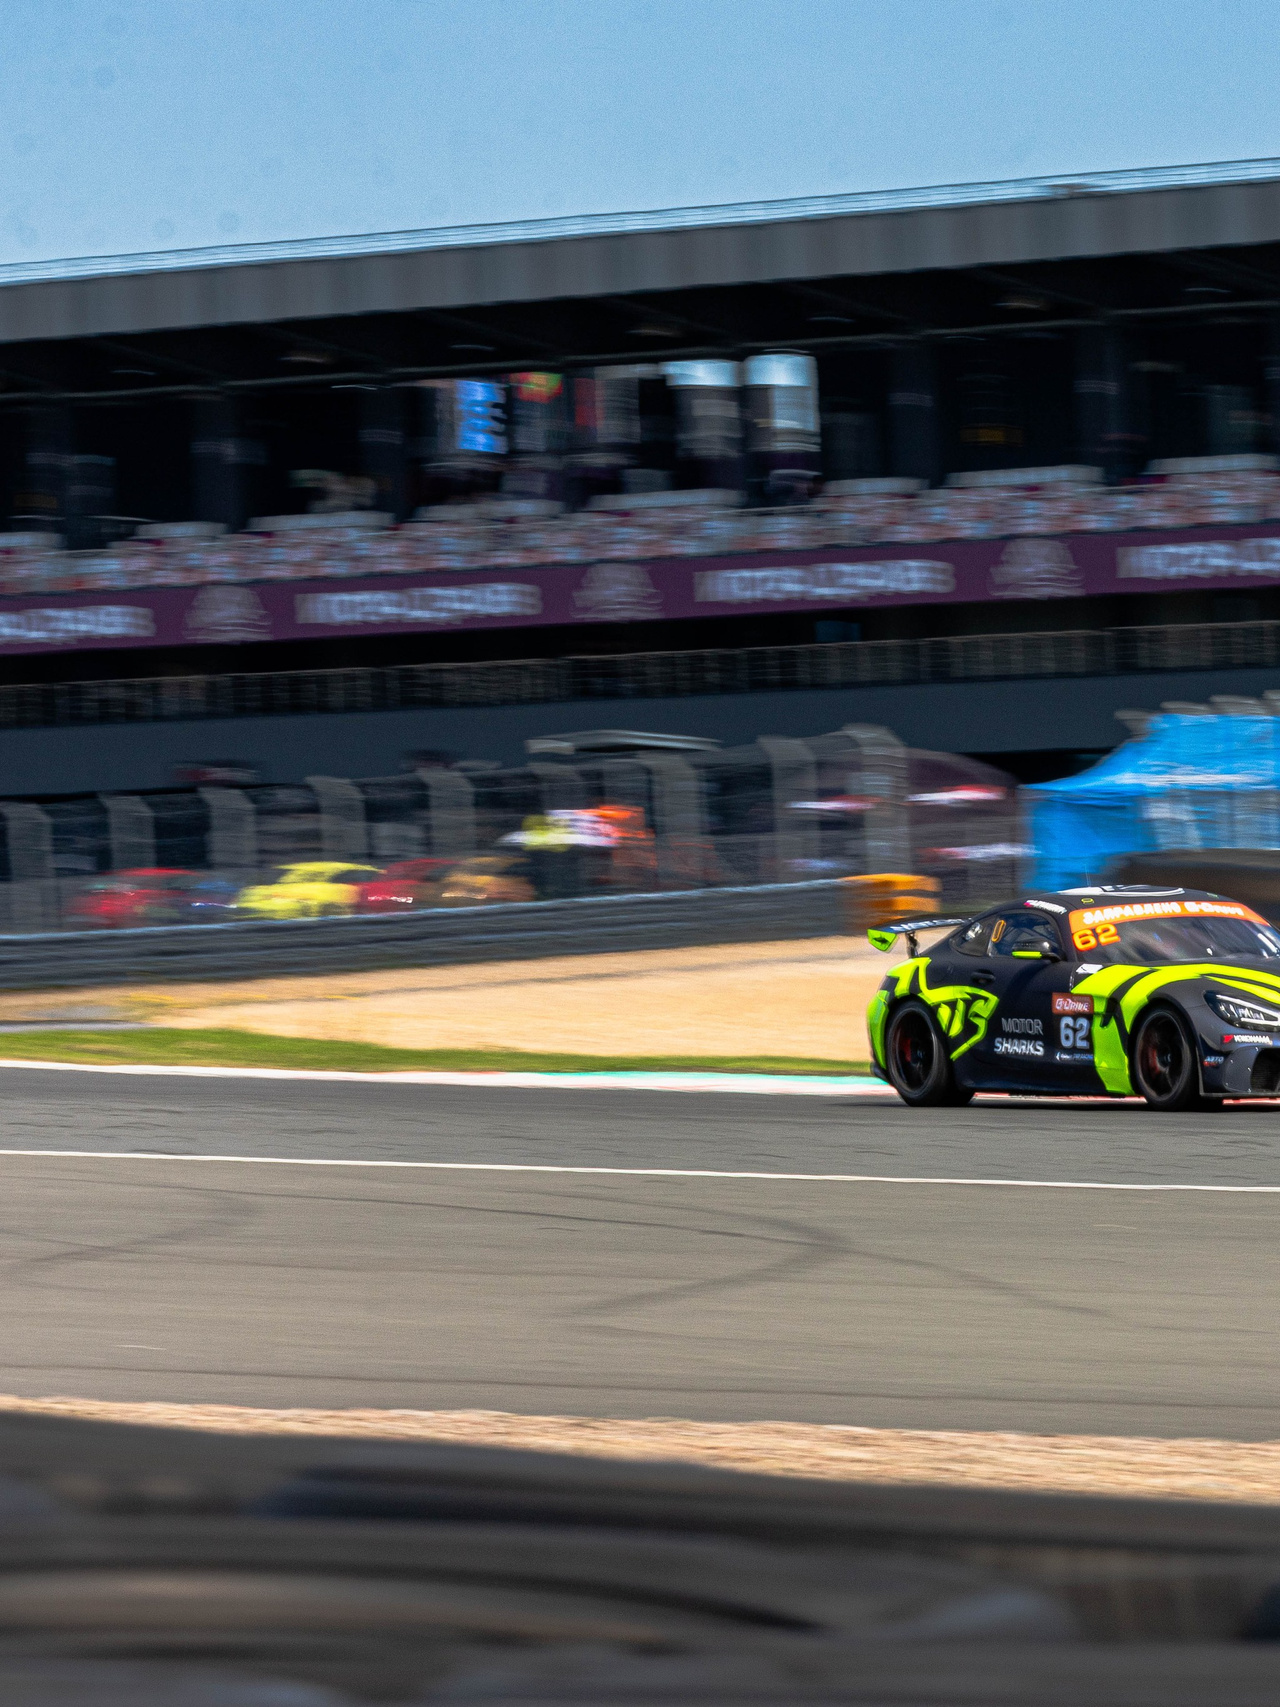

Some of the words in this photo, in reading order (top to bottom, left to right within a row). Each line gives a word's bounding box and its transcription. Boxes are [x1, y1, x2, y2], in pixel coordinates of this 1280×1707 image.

[1072, 923, 1121, 951] 62
[1001, 1018, 1044, 1036] MOTOR
[1060, 1016, 1090, 1049] 62
[994, 1037, 1045, 1056] SHARKS
